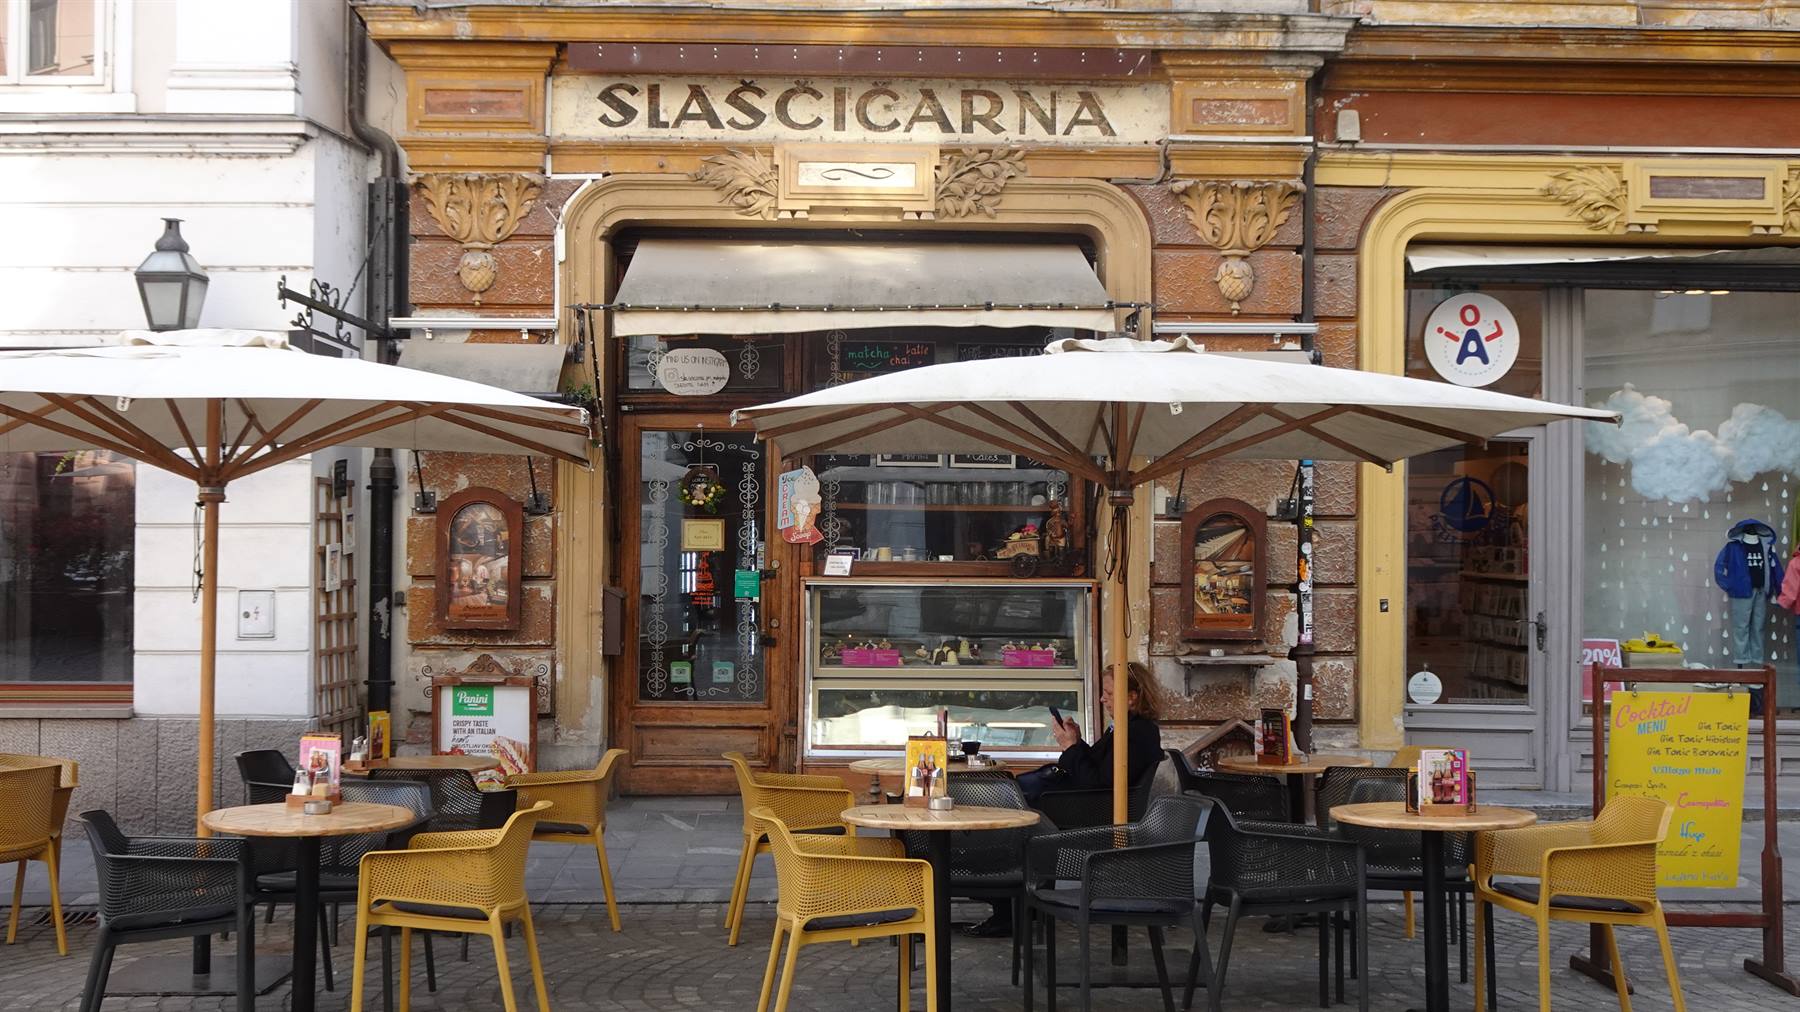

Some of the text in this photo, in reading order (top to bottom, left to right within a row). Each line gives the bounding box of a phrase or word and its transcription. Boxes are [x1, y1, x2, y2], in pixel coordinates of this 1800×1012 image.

[597, 79, 1117, 137] SLAŠČIČARNA
[848, 345, 890, 359] matcha
[457, 691, 489, 704] Panini
[1616, 696, 1692, 728] Cocktail
[473, 720, 489, 728] TASTE
[1637, 720, 1667, 735] MENU
[1697, 722, 1741, 731] Gin Tonic
[1660, 734, 1674, 743] Gin
[1678, 734, 1704, 743] Tonic
[1647, 747, 1661, 756] Gin
[1665, 747, 1691, 757] Tonic
[1680, 821, 1705, 842] Hugo
